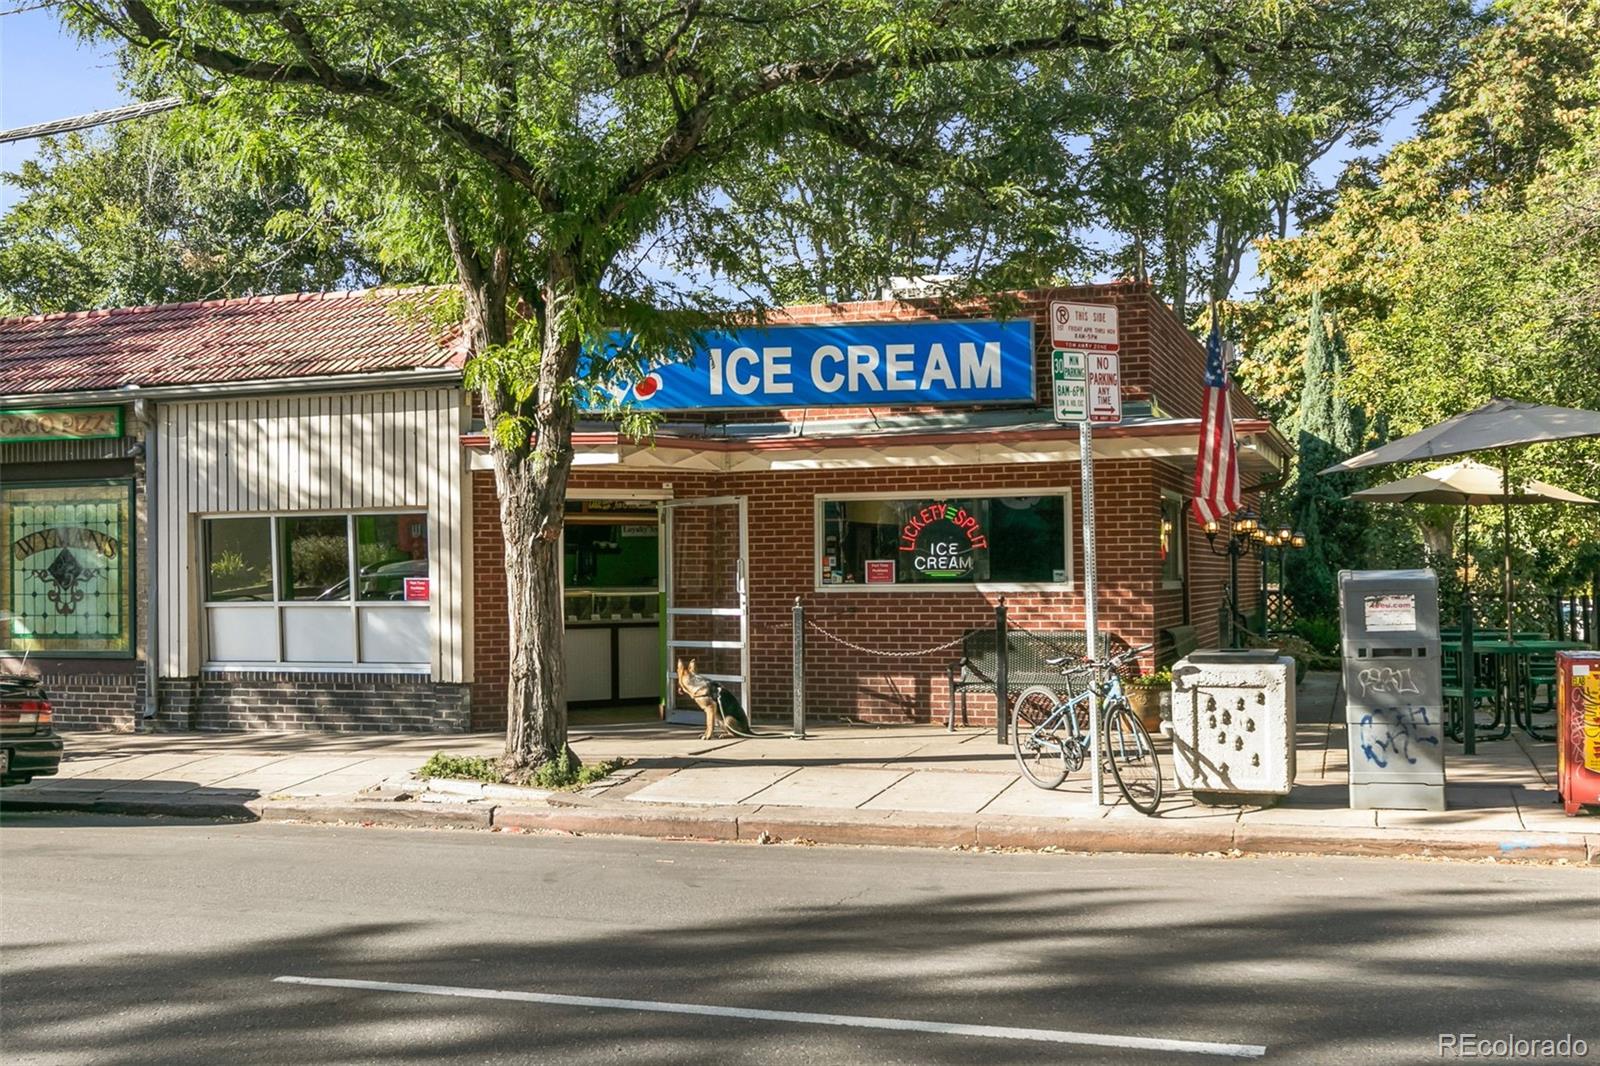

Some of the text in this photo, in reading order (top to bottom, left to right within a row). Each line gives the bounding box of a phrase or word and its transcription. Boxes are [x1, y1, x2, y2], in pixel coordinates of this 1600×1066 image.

[1075, 311, 1106, 322] THIS SIDE
[1054, 358, 1063, 374] 30
[1069, 356, 1079, 366] MIN
[1097, 356, 1108, 370] NO
[709, 342, 1002, 395] ICE CREAM
[1064, 368, 1086, 378] PARKING
[1090, 372, 1118, 386] PARKING
[1058, 385, 1084, 396] 8AM-6PM
[1098, 387, 1110, 396] ANY
[1098, 396, 1112, 406] TIME
[899, 504, 988, 551] LICKETY SPLIT
[930, 542, 958, 555] ICE
[914, 556, 973, 570] CREAM
